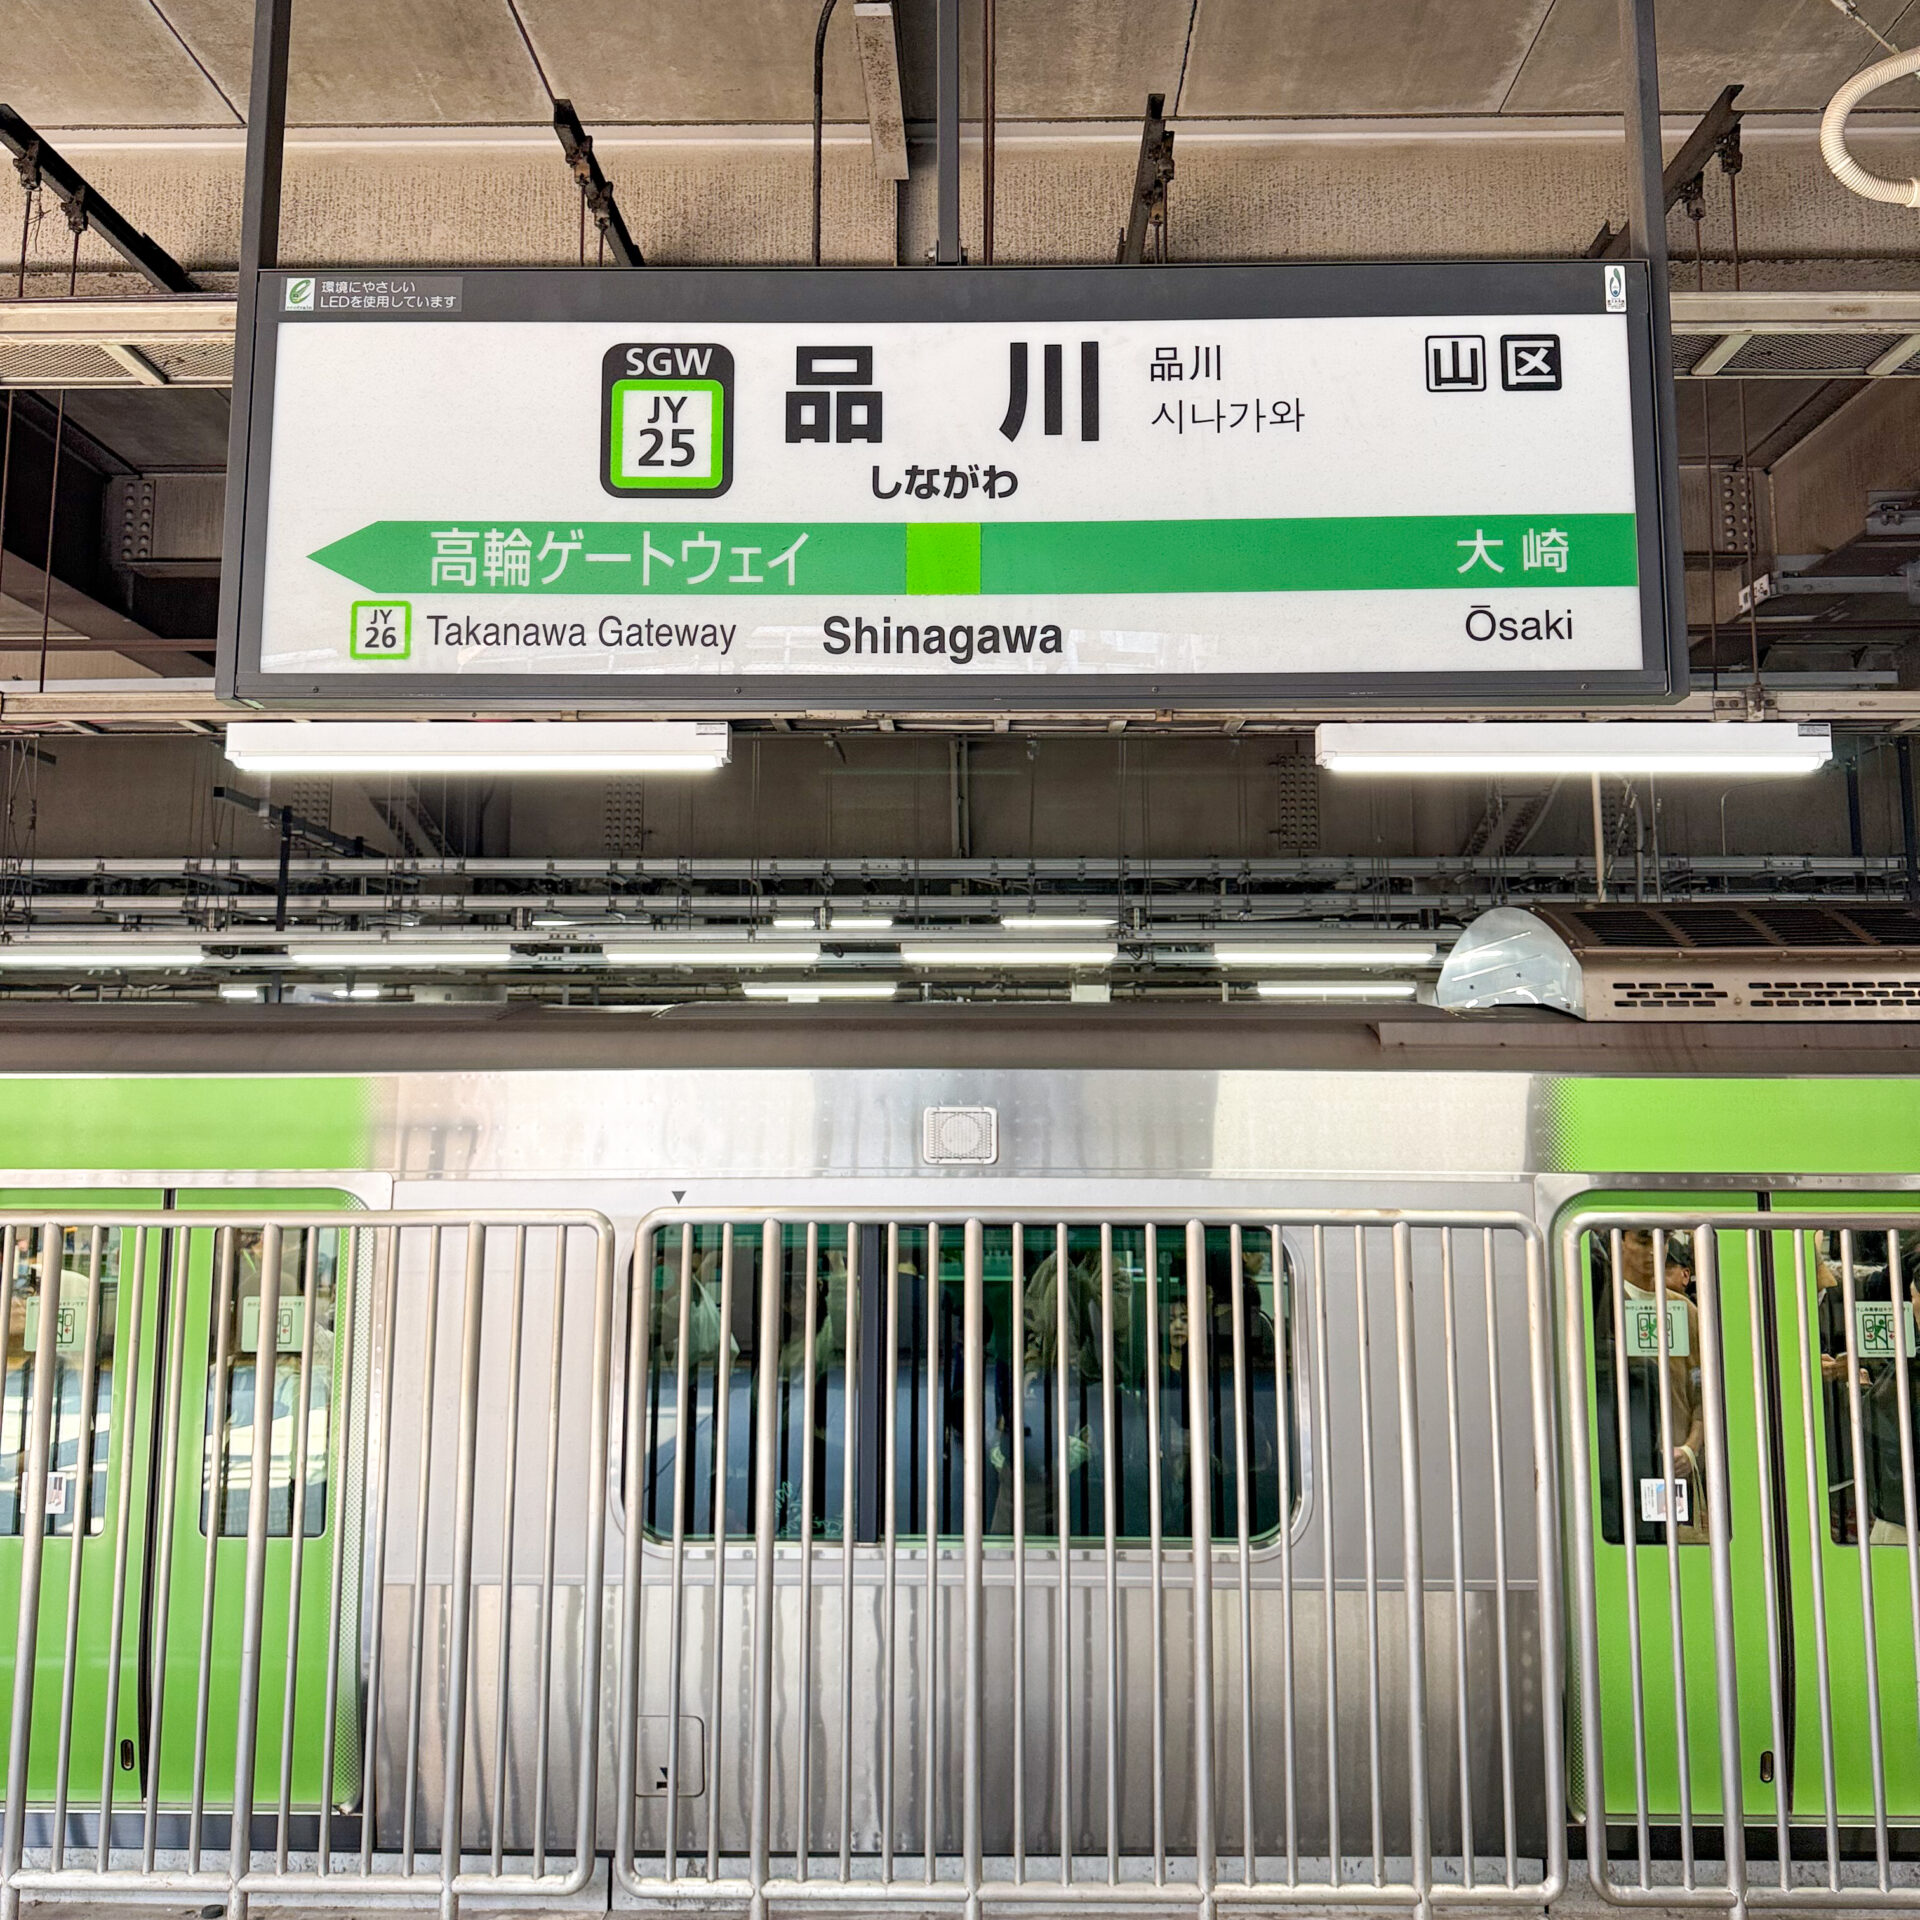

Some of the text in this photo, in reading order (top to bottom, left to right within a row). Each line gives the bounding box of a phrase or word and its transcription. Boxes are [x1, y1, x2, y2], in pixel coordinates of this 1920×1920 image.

[320, 295, 457, 309] LEDを使用しています
[321, 281, 416, 294] 環境にやさしい
[626, 347, 713, 376] SGW
[1150, 344, 1222, 382] 品川
[647, 396, 688, 424] JY
[785, 341, 1100, 444] 品川
[1151, 397, 1306, 435] 시나가와
[638, 428, 696, 467] 25
[872, 463, 1019, 500] しながわ
[430, 527, 809, 588] 高輪ゲートウェイ
[1456, 527, 1569, 574] 大崎
[370, 609, 393, 625] JY
[426, 615, 737, 656] Takanawa Gateway
[1465, 604, 1573, 642] Ōsaki
[364, 627, 397, 649] 26
[822, 615, 1063, 665] Shinagawa
